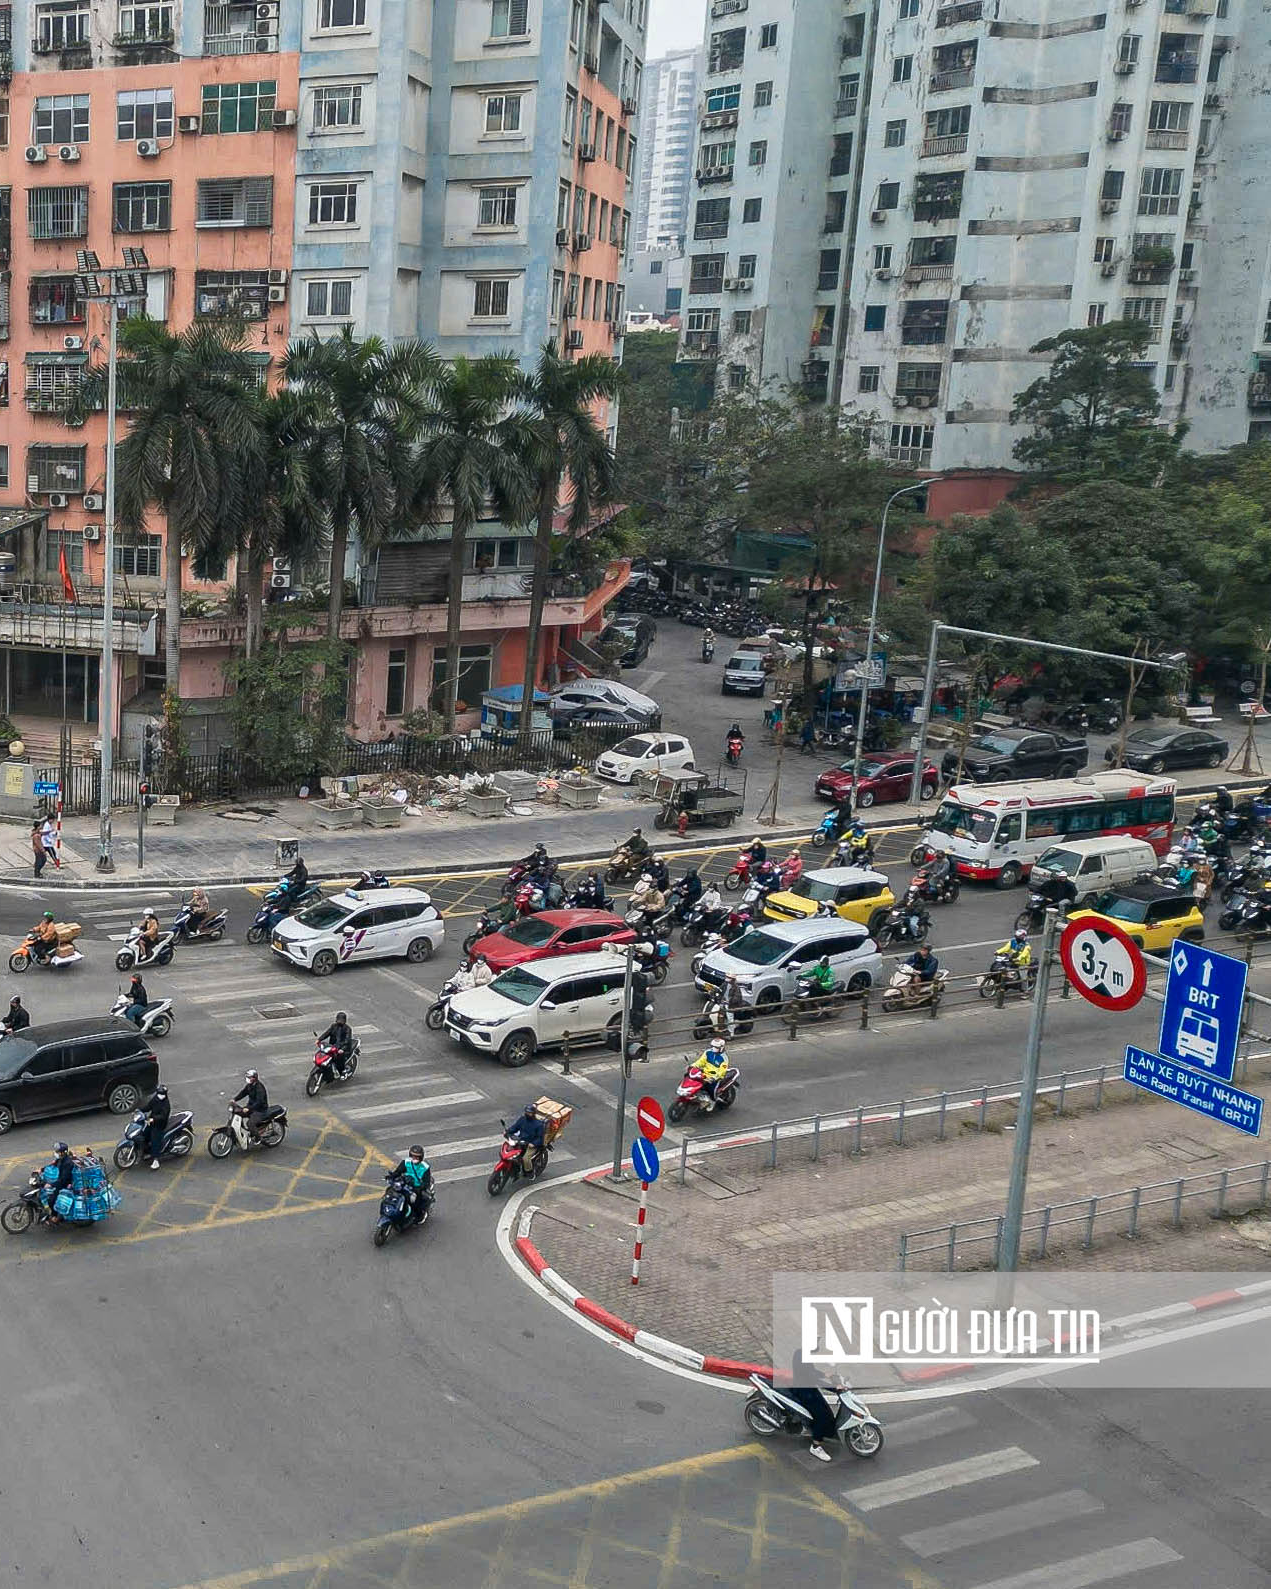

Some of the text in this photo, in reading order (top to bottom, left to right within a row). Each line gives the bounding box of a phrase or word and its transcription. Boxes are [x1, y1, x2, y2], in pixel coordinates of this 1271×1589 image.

[1112, 970, 1124, 987] m
[1188, 986, 1220, 1009] BRT
[1129, 1066, 1254, 1128] Bus Rapid Transit (BRT)
[1130, 1052, 1257, 1115] LÀN XE BUÝT NHANH
